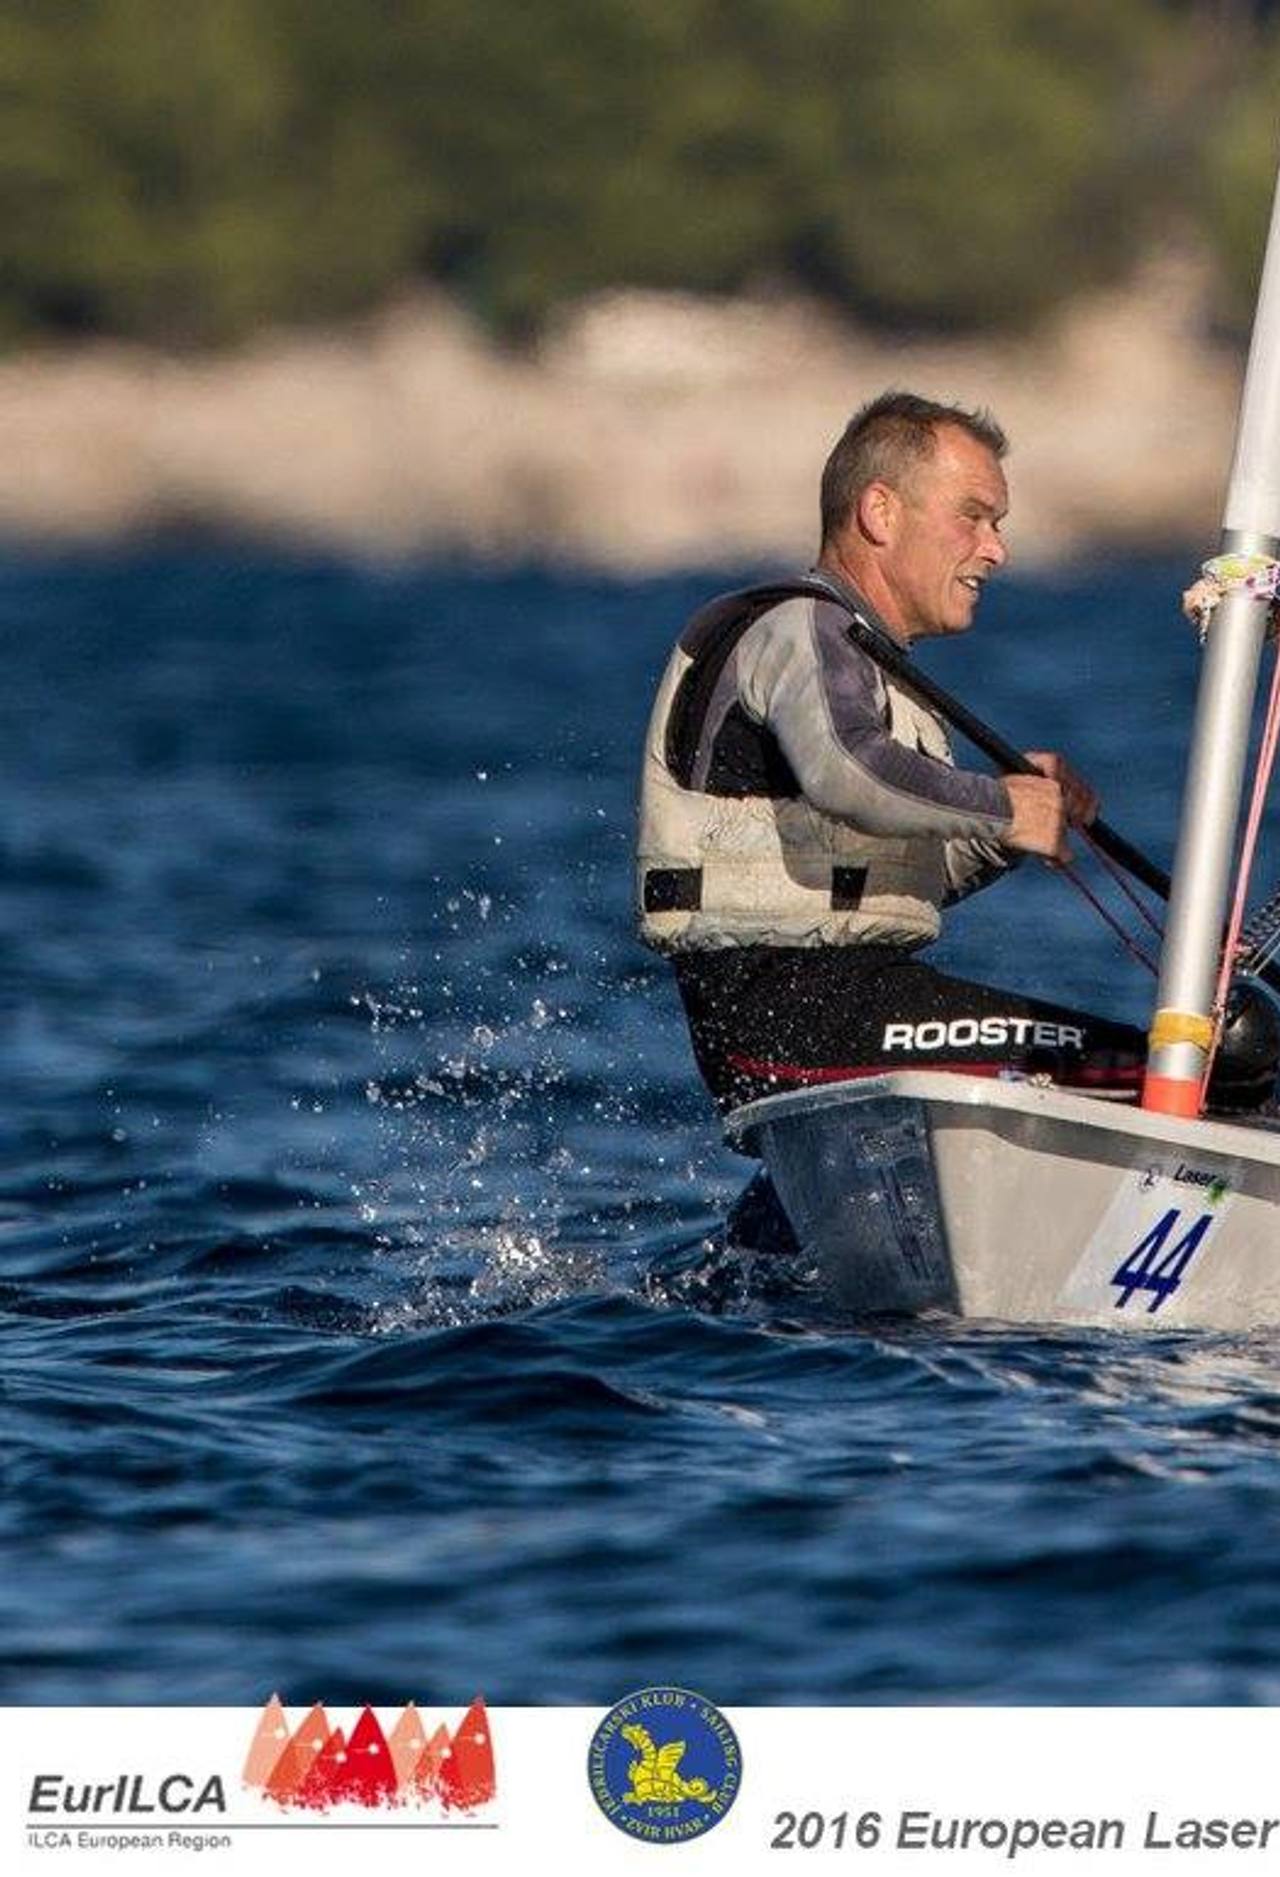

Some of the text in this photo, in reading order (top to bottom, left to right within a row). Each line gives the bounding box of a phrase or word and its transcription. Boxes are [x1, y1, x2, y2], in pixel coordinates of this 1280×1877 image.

[882, 1017, 1083, 1050] ROOSTER
[1174, 1163, 1217, 1187] Laser
[1110, 1208, 1214, 1314] 44
